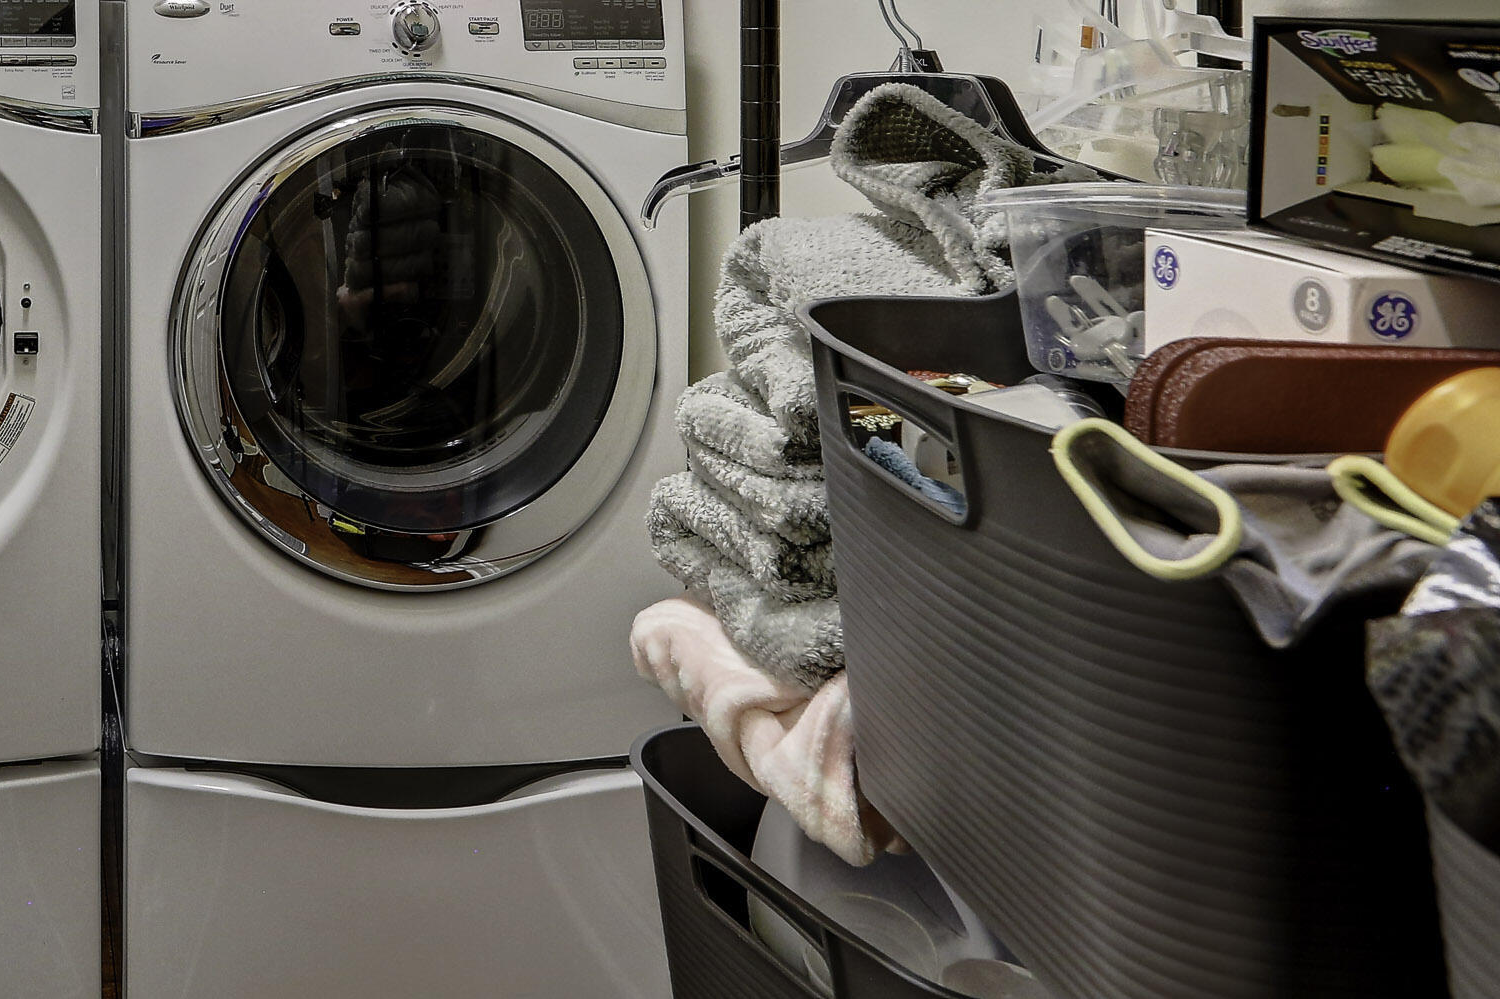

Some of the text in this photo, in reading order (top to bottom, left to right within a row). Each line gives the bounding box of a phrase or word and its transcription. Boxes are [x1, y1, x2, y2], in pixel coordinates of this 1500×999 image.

[219, 2, 235, 11] Duet
[1299, 31, 1377, 53] Swiffer
[1343, 68, 1417, 86] HEAVY
[1365, 82, 1434, 101] DUTY
[1305, 287, 1320, 311] 8
[1373, 297, 1412, 334] GE
